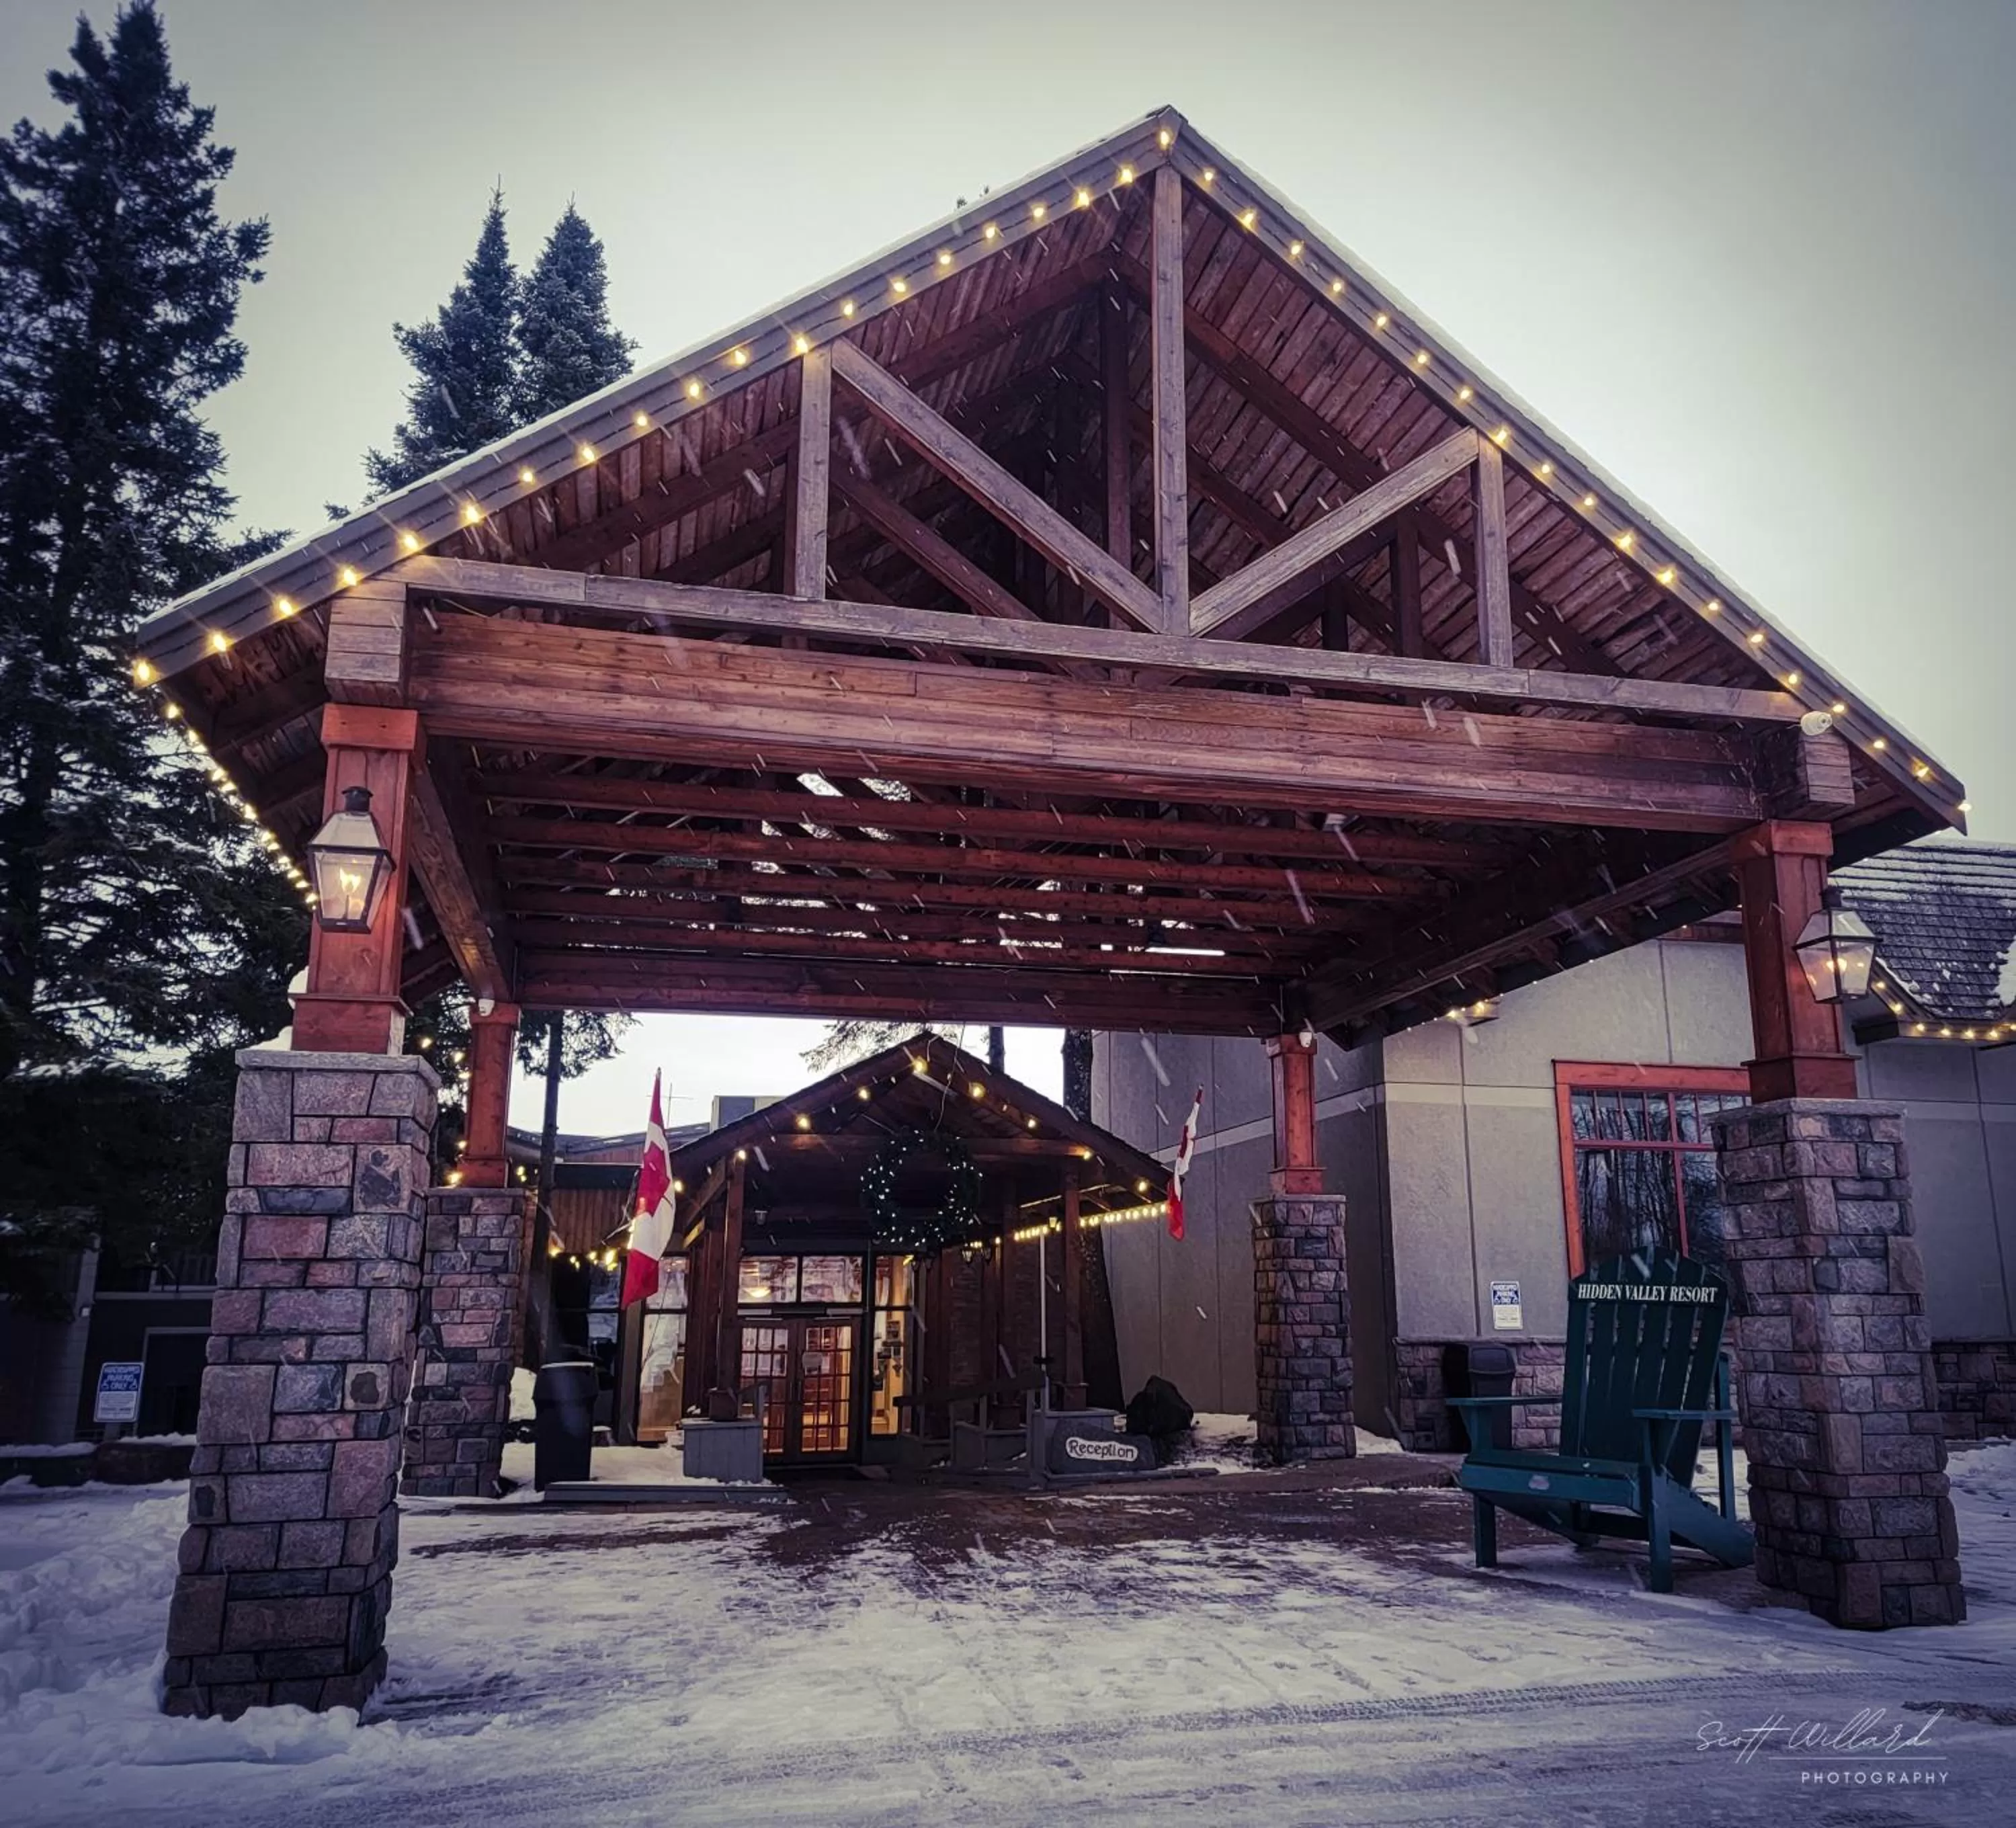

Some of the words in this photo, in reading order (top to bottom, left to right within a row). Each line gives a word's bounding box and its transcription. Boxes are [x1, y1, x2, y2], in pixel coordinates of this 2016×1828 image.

[1578, 1284, 1623, 1299] HIDDEN
[1625, 1284, 1668, 1301] VALLEY
[1669, 1286, 1718, 1303] RESORT
[1068, 1439, 1134, 1459] Reception
